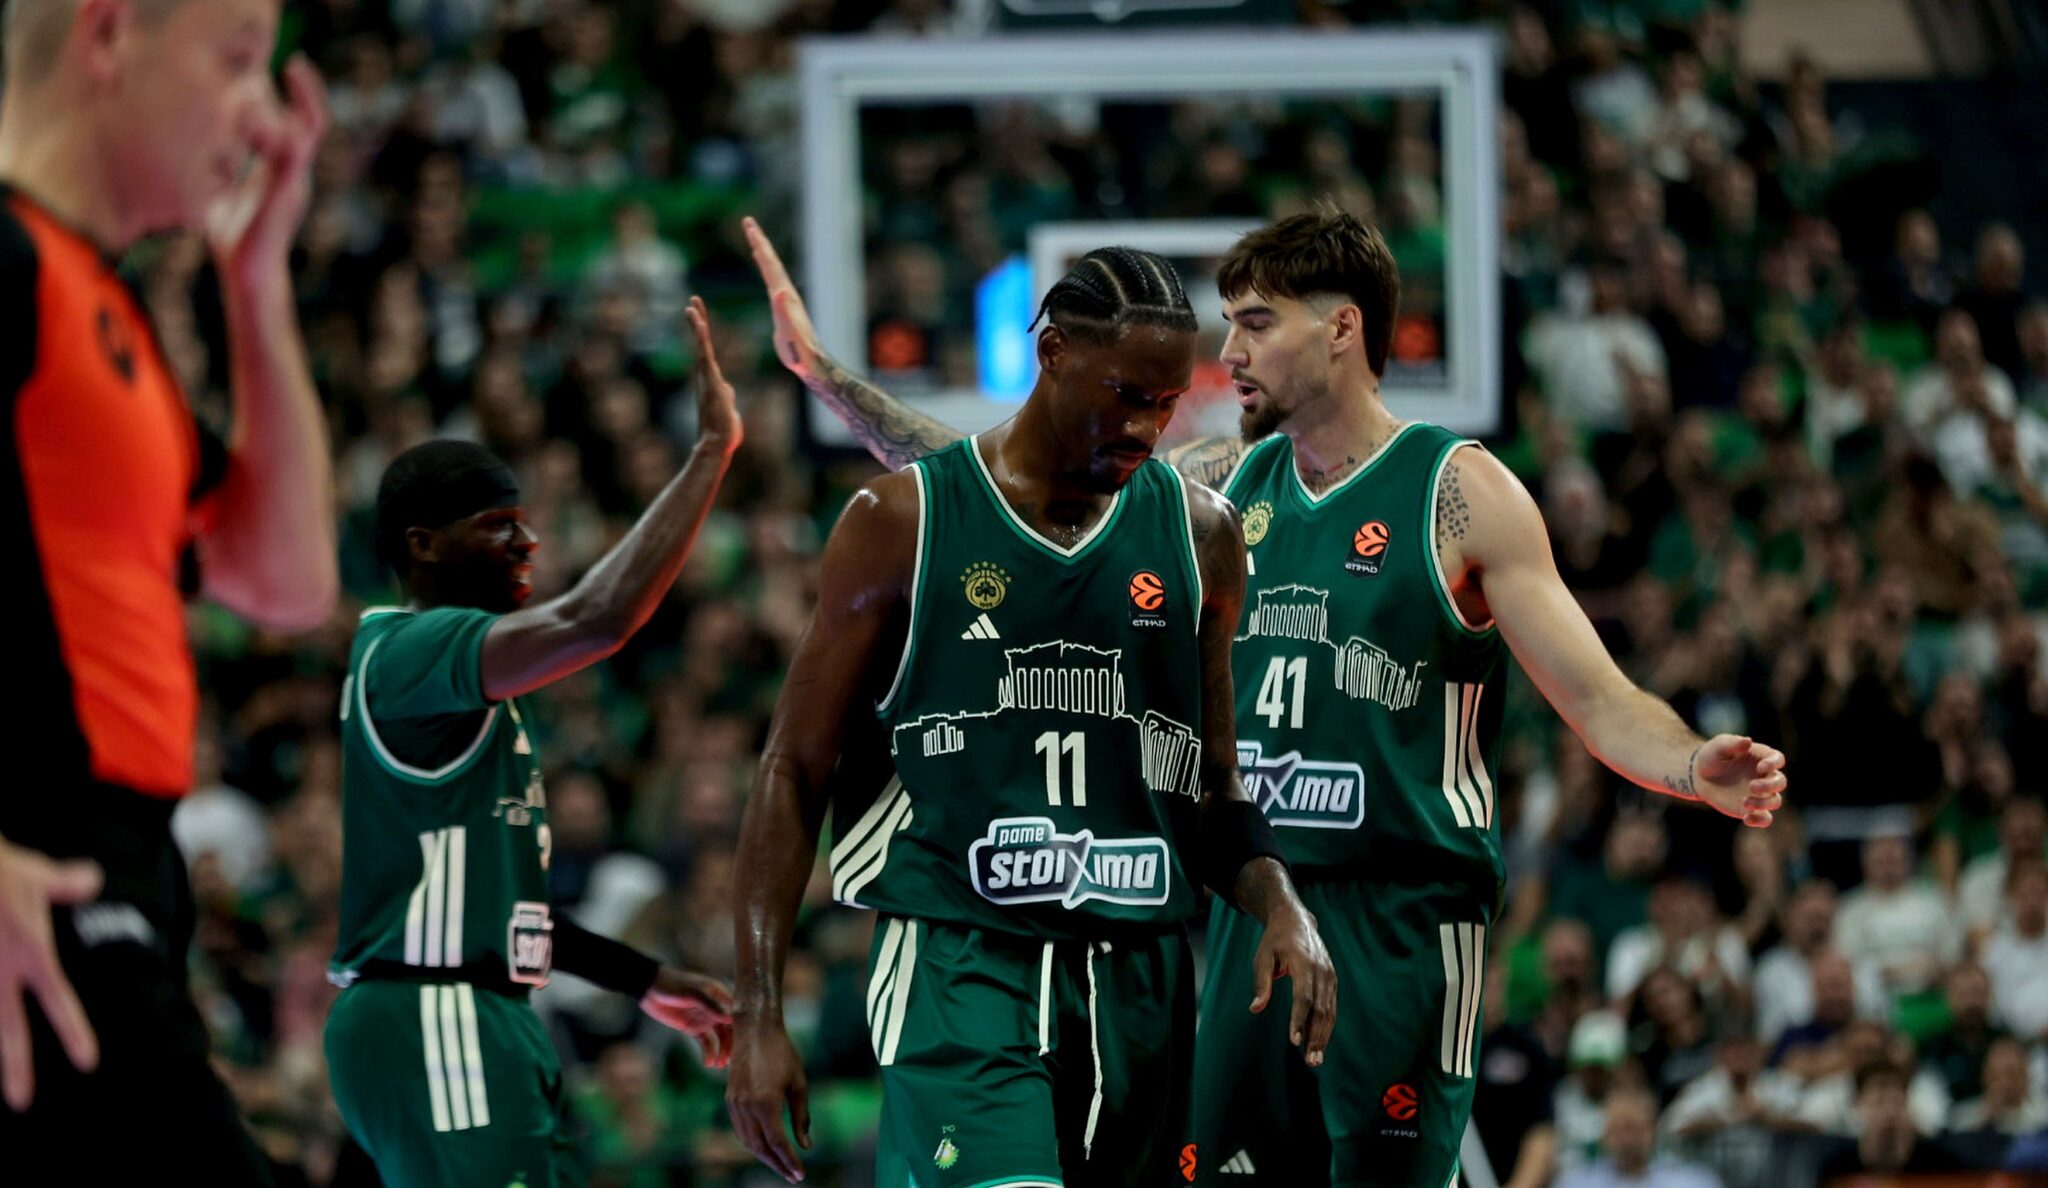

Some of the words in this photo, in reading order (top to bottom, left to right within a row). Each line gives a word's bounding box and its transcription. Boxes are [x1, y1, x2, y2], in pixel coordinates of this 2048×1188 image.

[1132, 619, 1167, 627] ETIHAD
[1256, 656, 1308, 729] 41
[1035, 731, 1087, 806] 11
[998, 826, 1045, 847] pame
